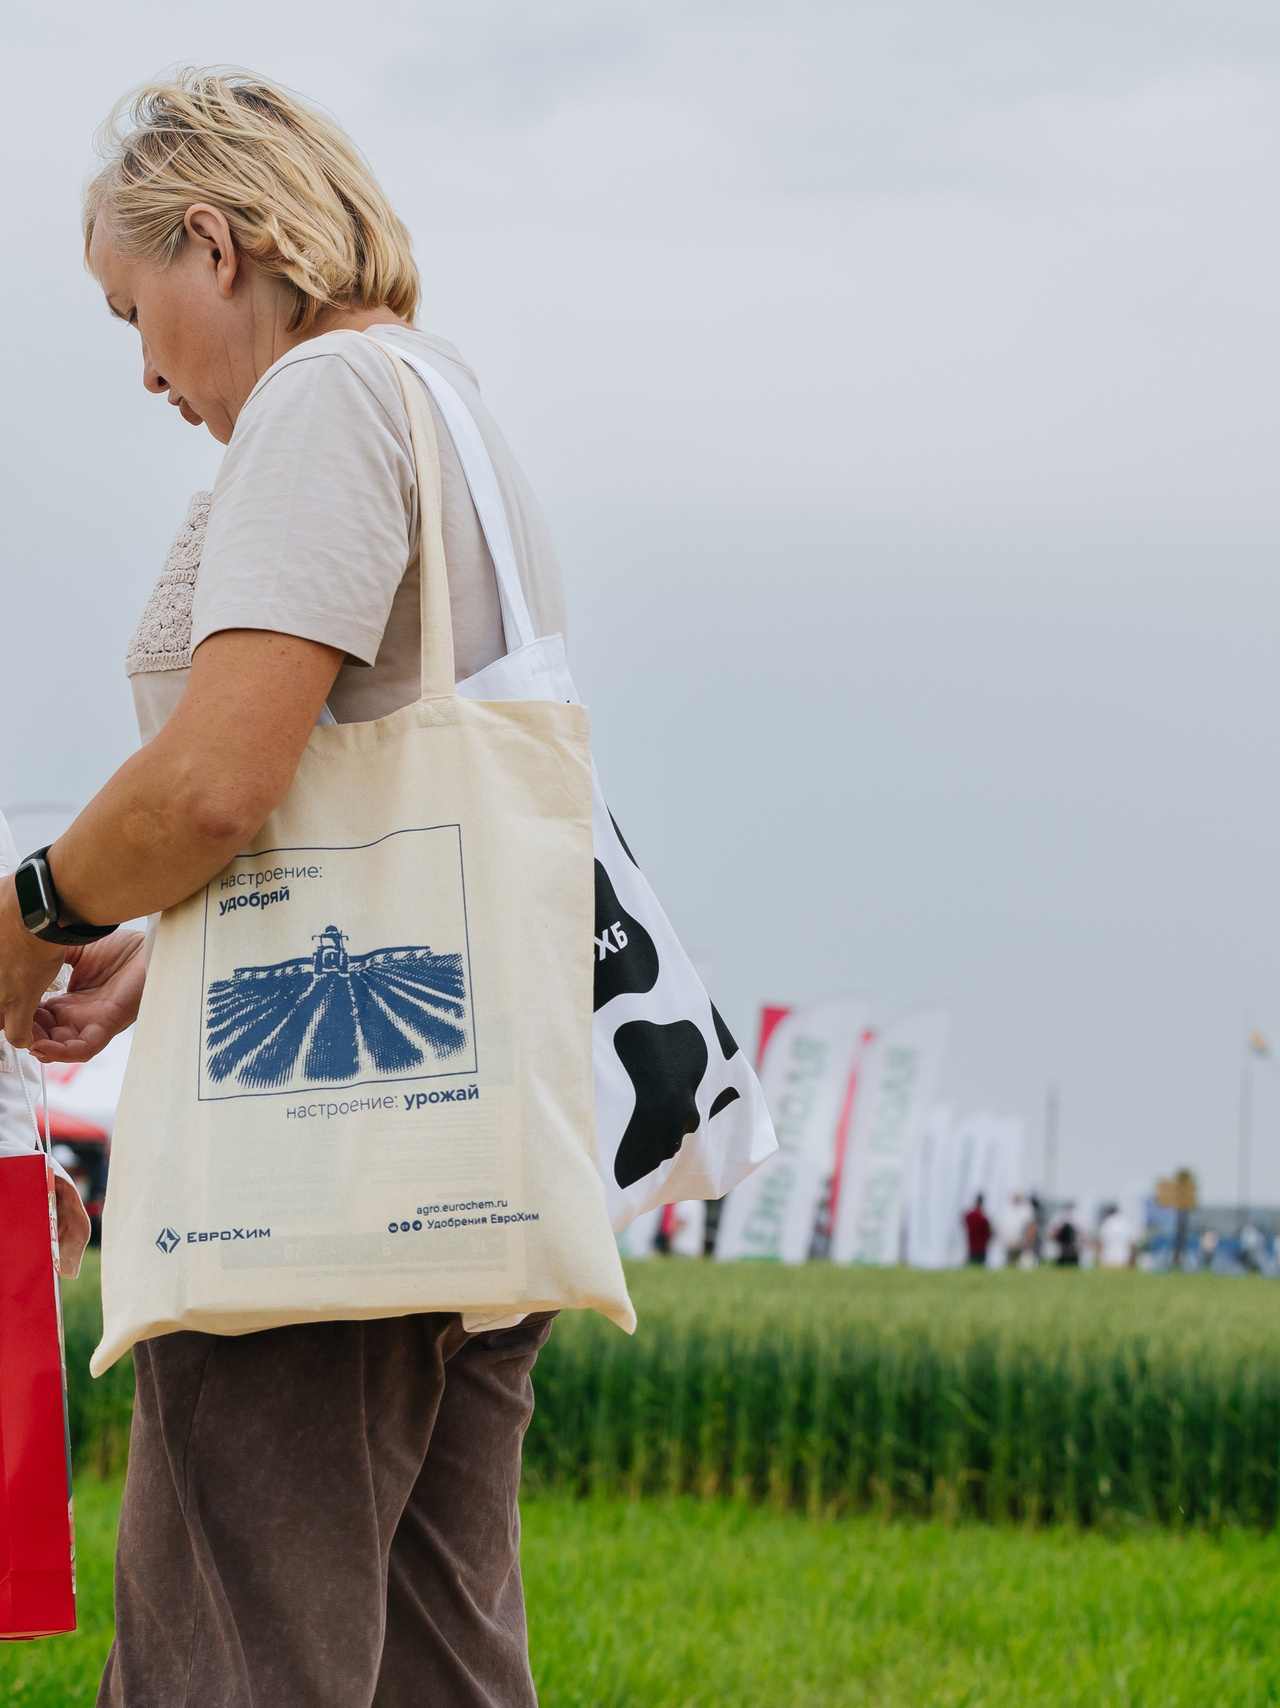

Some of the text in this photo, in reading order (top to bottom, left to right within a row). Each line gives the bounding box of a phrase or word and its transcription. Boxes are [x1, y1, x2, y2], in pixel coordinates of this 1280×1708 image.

[220, 865, 323, 891] настроение:
[219, 885, 291, 916] удобряй
[593, 920, 629, 961] ХБ
[286, 1084, 480, 1119] настроение: урожай
[416, 1200, 508, 1216] agro.eurochem.ru
[427, 1211, 540, 1230] Удобрения ЕвроХим
